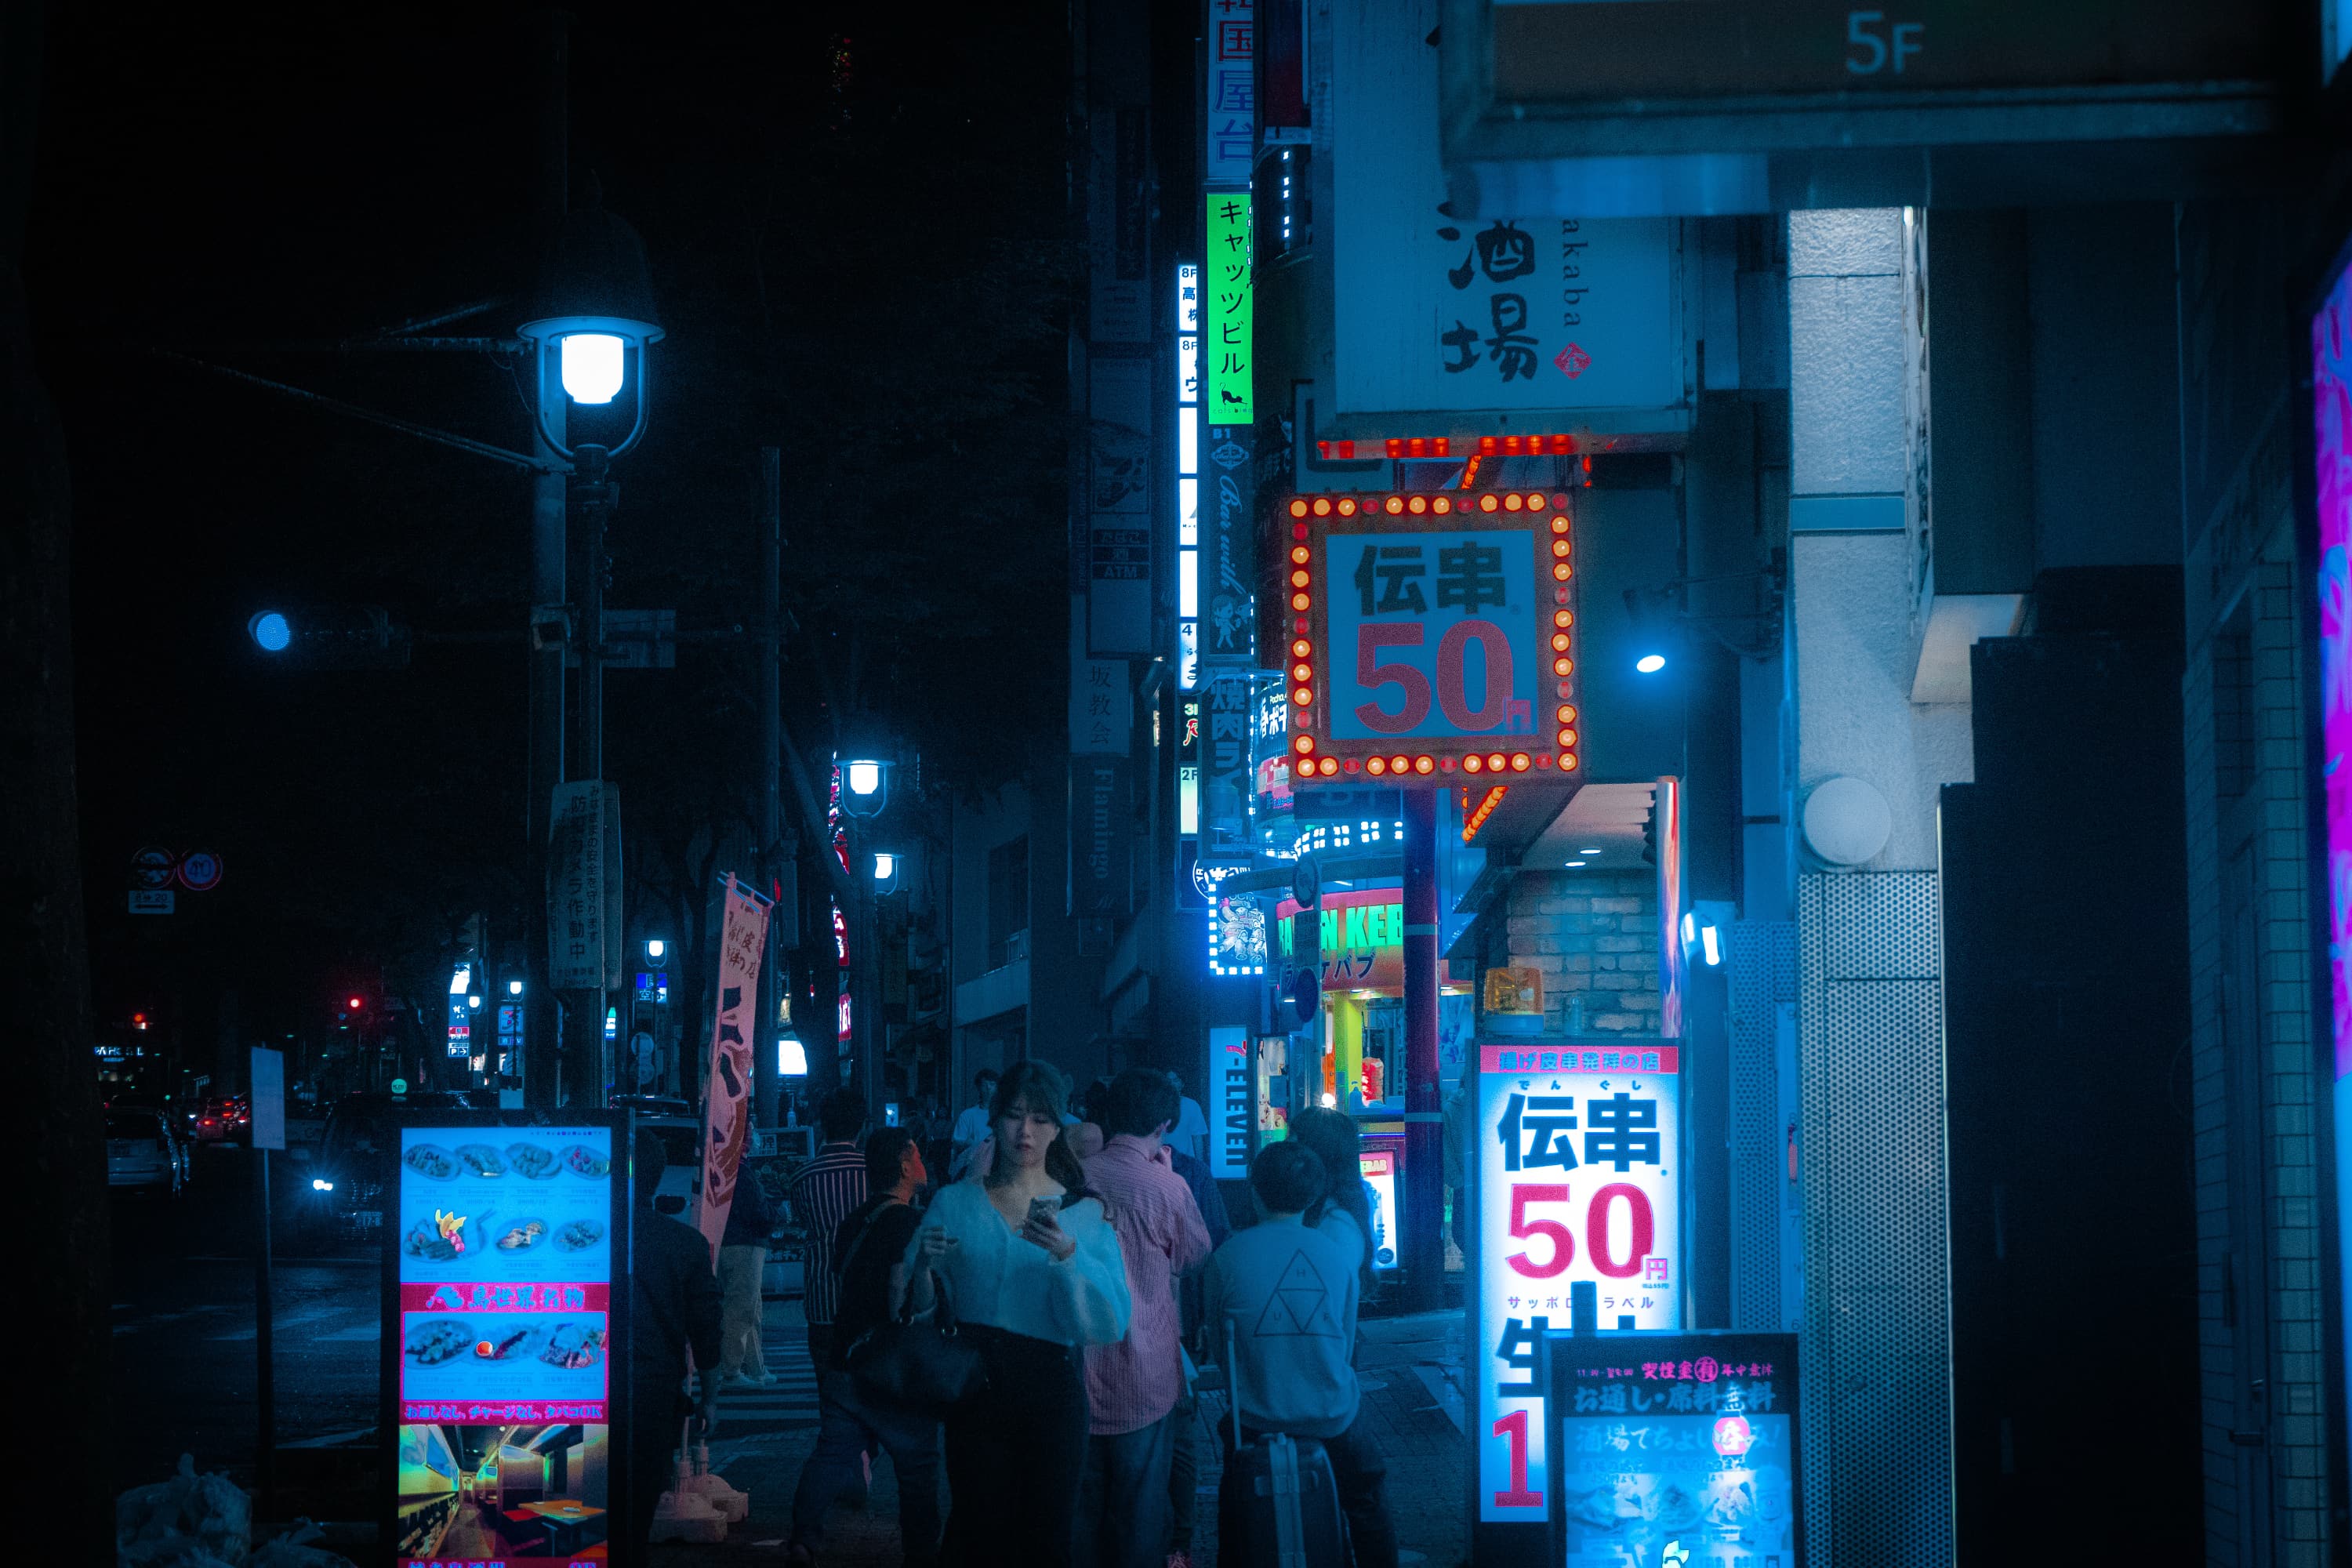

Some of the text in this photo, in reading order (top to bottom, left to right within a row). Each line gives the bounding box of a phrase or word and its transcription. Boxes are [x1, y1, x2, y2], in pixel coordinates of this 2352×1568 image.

[1845, 9, 1926, 74] 5F
[1215, 0, 1253, 162] 国屋台
[1220, 201, 1245, 374] キャッツビル
[1104, 565, 1138, 578] ATM
[1355, 541, 1506, 615] 伝串
[1182, 769, 1198, 781] 2F
[1091, 767, 1115, 880] Flamingo
[187, 859, 212, 877] 40
[1346, 904, 1403, 949] KEB
[1518, 1080, 1642, 1091] でんぐし
[1497, 1093, 1661, 1171] 伝串
[1505, 1183, 1668, 1280] 50円
[1297, 1269, 1305, 1277] H
[1507, 1296, 1654, 1310] サッポロラベル
